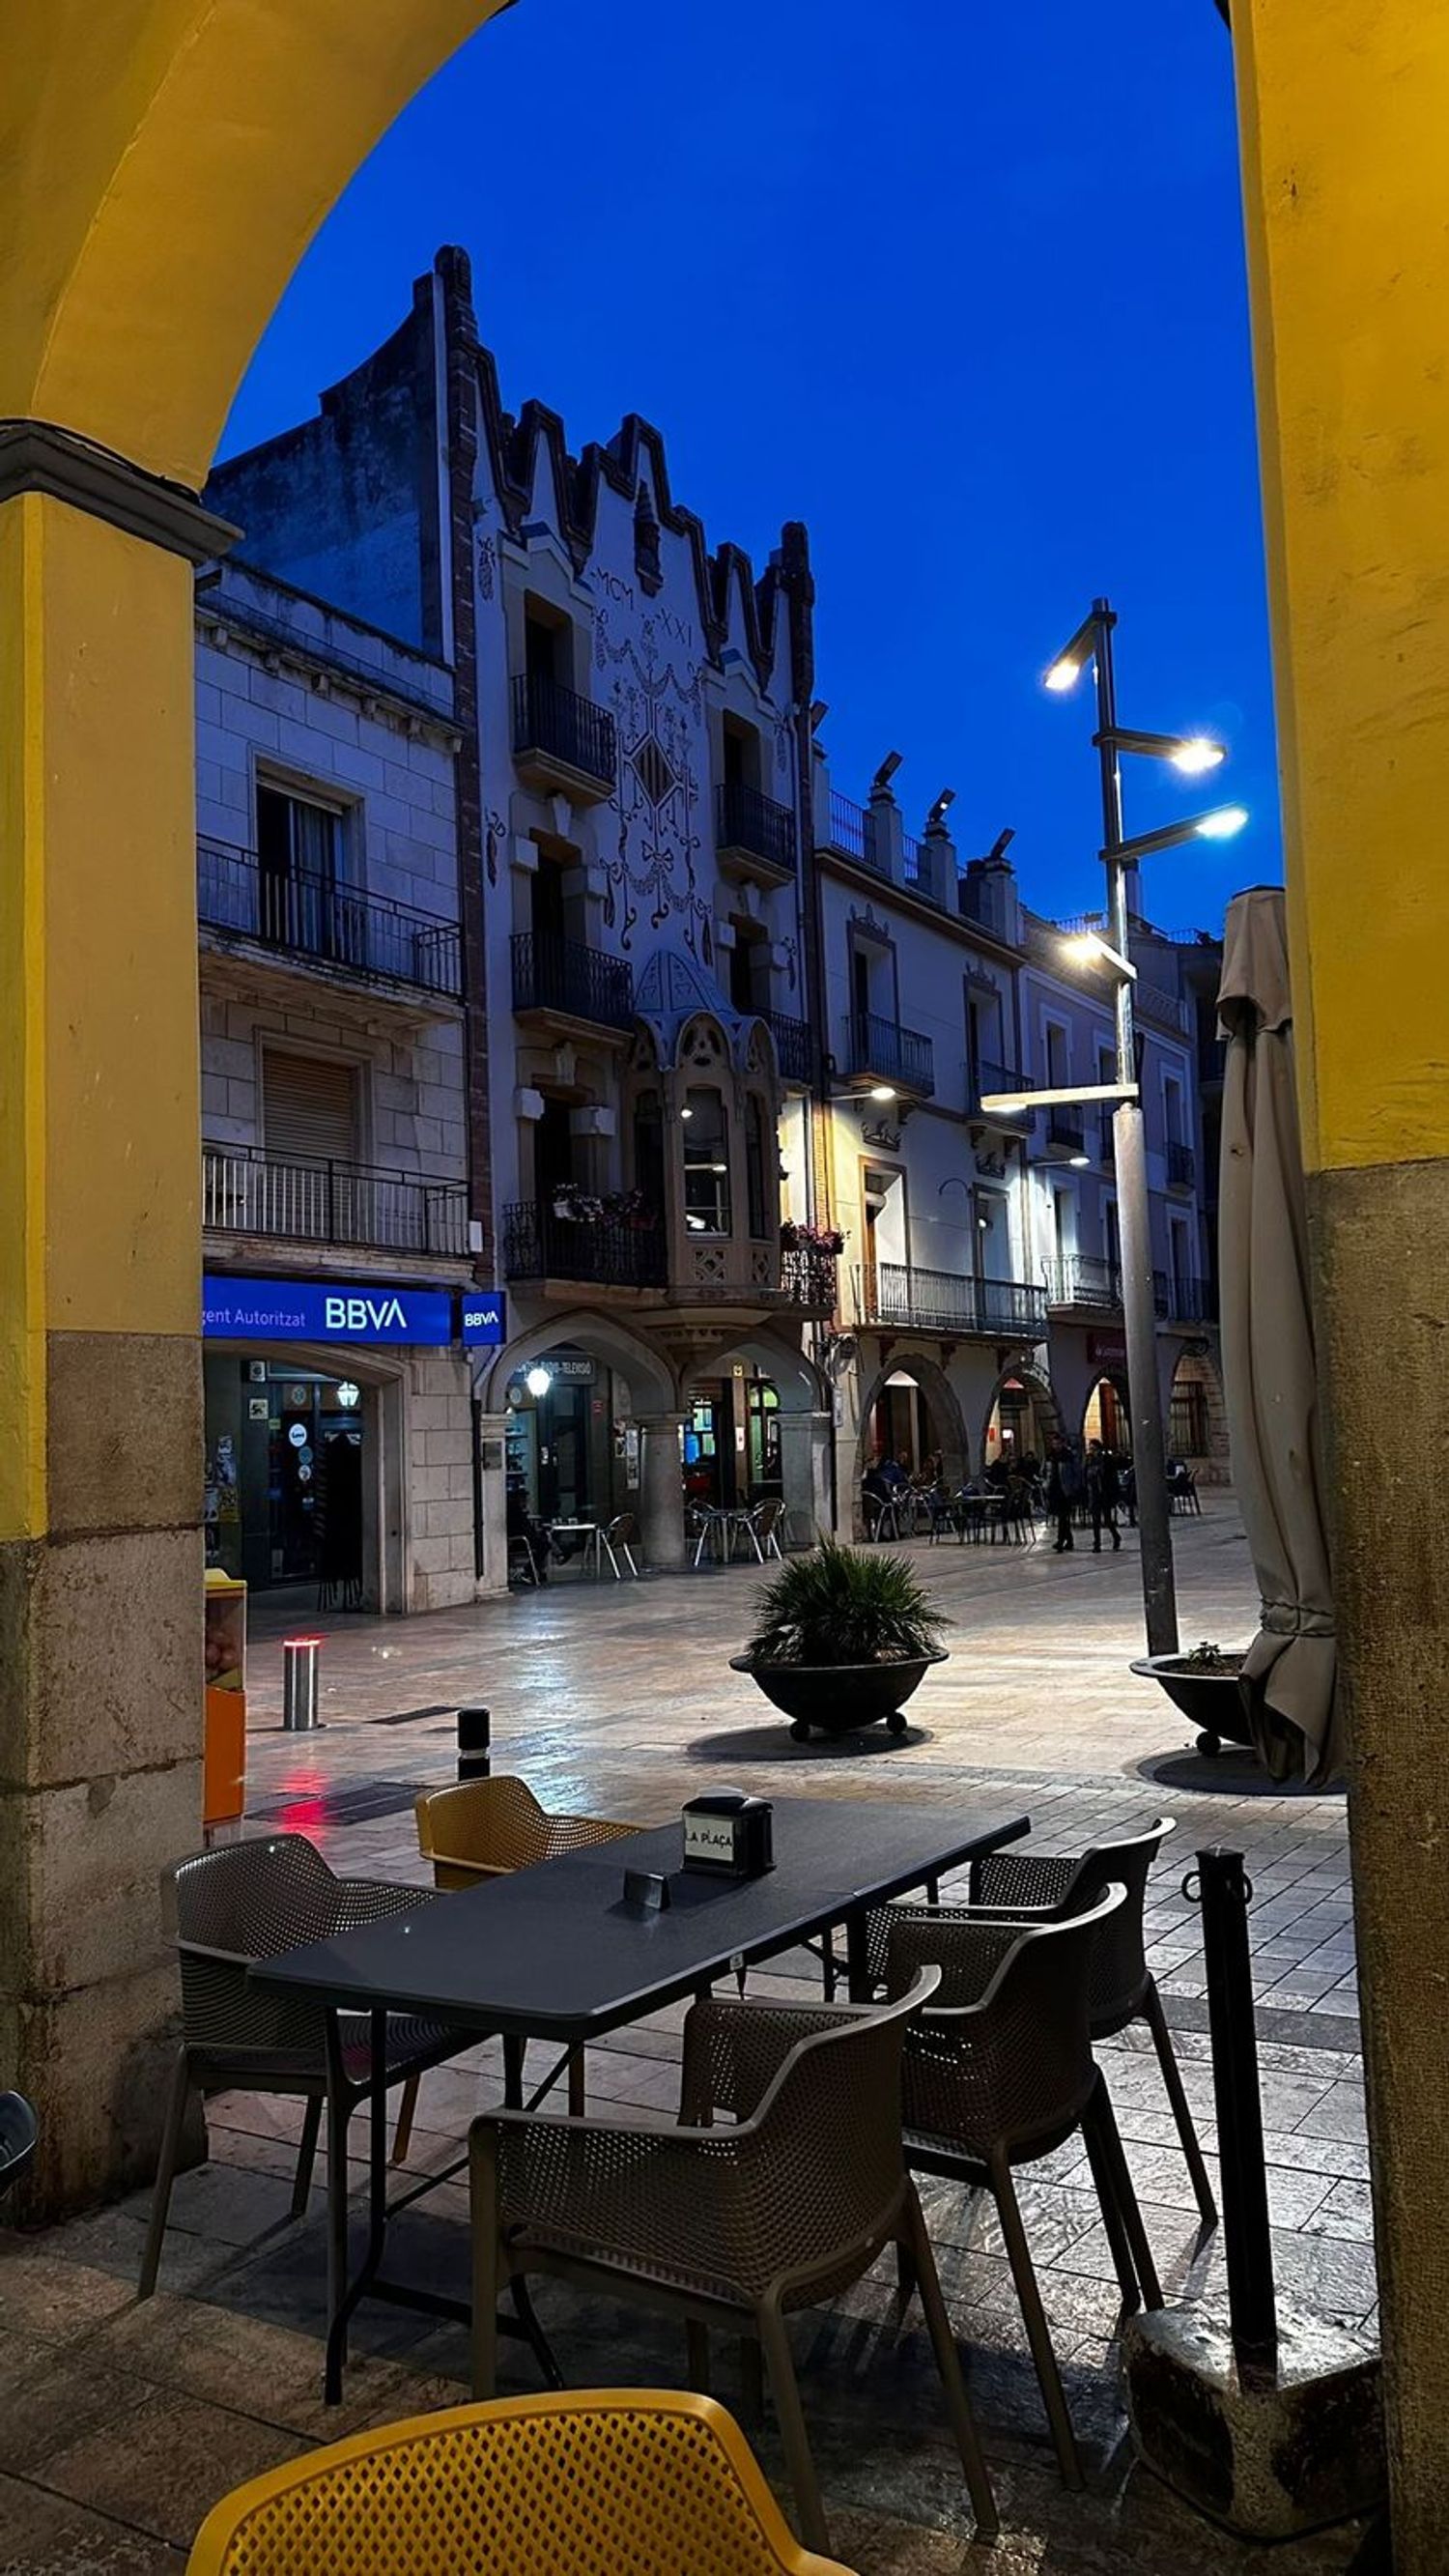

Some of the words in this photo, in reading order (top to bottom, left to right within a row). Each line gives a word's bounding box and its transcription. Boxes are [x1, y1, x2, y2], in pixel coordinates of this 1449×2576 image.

[202, 1309, 232, 1326] ent
[234, 1308, 305, 1328] Autoritzat
[326, 1298, 407, 1331] BBVA
[465, 1310, 498, 1327] BBVA
